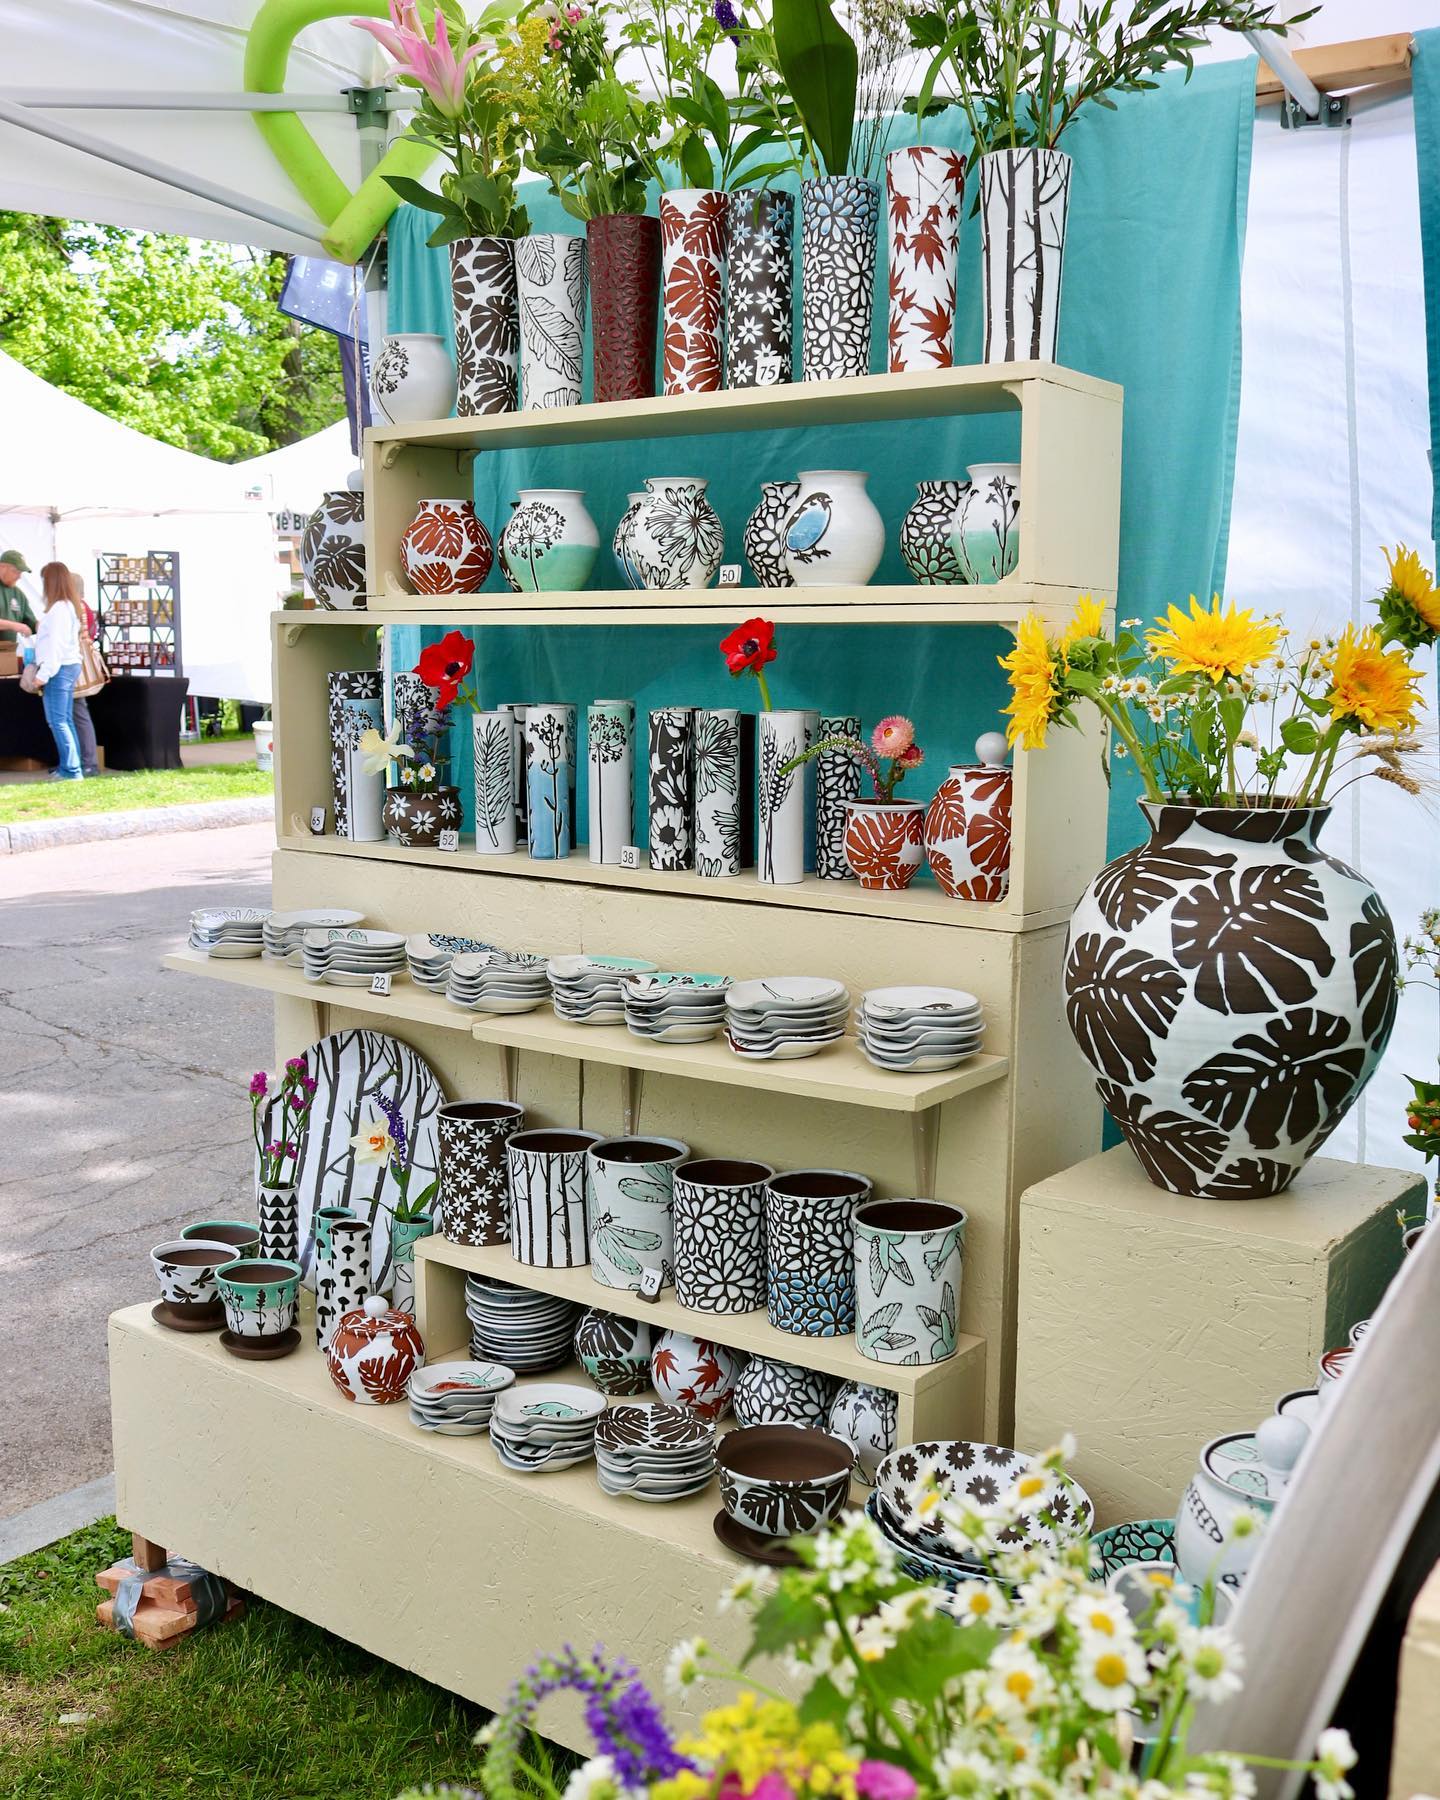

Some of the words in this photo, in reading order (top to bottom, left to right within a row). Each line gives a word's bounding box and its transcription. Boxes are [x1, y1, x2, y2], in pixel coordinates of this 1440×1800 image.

[760, 364, 776, 381] 75
[722, 569, 735, 582] 50
[441, 834, 454, 846] 52
[622, 850, 634, 864] 38
[374, 976, 386, 990] 22
[644, 1275, 656, 1289] 72
